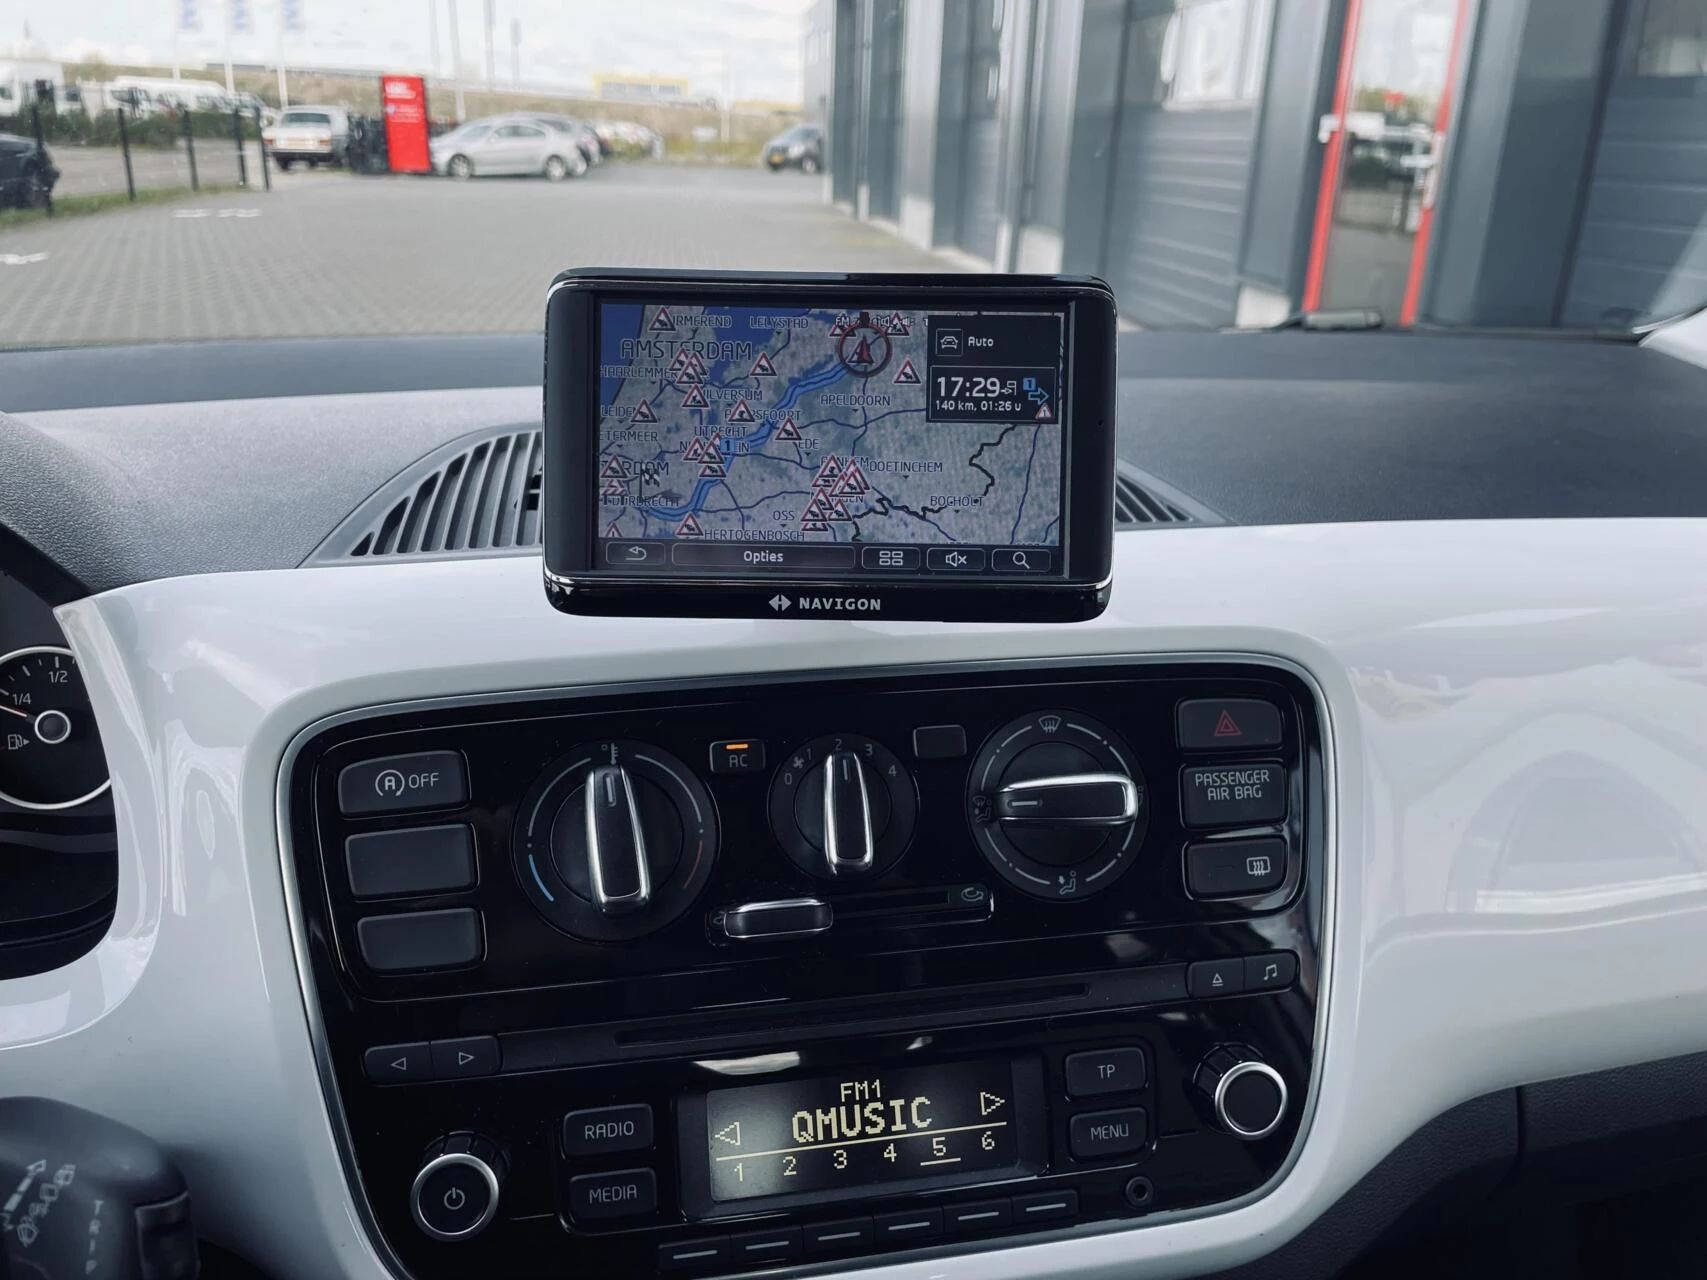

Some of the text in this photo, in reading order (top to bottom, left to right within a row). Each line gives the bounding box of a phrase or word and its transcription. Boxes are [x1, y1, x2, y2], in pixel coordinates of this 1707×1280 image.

[751, 316, 808, 328] LELYSTAD
[968, 336, 994, 347] Auto
[621, 339, 751, 361] AMSTERDAM
[936, 377, 1001, 397] 17:29
[821, 395, 891, 406] APELDOORN
[936, 400, 1021, 412] 140 km, 01:26 u
[798, 439, 819, 449] EDE
[869, 461, 943, 473] DOETINCHEM
[930, 496, 984, 507] BOCHOLT
[772, 511, 795, 521] OSS
[704, 530, 805, 541] HERTOGENBOSCH
[743, 550, 784, 564] Opties
[799, 597, 881, 611] NAVIGON
[48, 670, 68, 683] 1/2
[12, 692, 31, 705] 1/4
[834, 738, 843, 751] 2
[865, 743, 873, 756] 3
[806, 748, 812, 760] 1
[729, 754, 748, 768] AC
[888, 764, 897, 776] 4
[408, 772, 439, 789] OFF
[784, 773, 793, 785] 0
[1195, 769, 1270, 787] PASSENGER
[1207, 784, 1262, 800] AIR BAG
[1097, 1064, 1115, 1079] TP
[840, 1079, 881, 1102] FM1
[792, 1097, 932, 1143] QMUSIC
[584, 1121, 634, 1140] RADIO
[1090, 1123, 1129, 1140] MENU
[734, 1131, 995, 1181] 1 2 3 4 5 6
[589, 1184, 637, 1204] MEDIA
